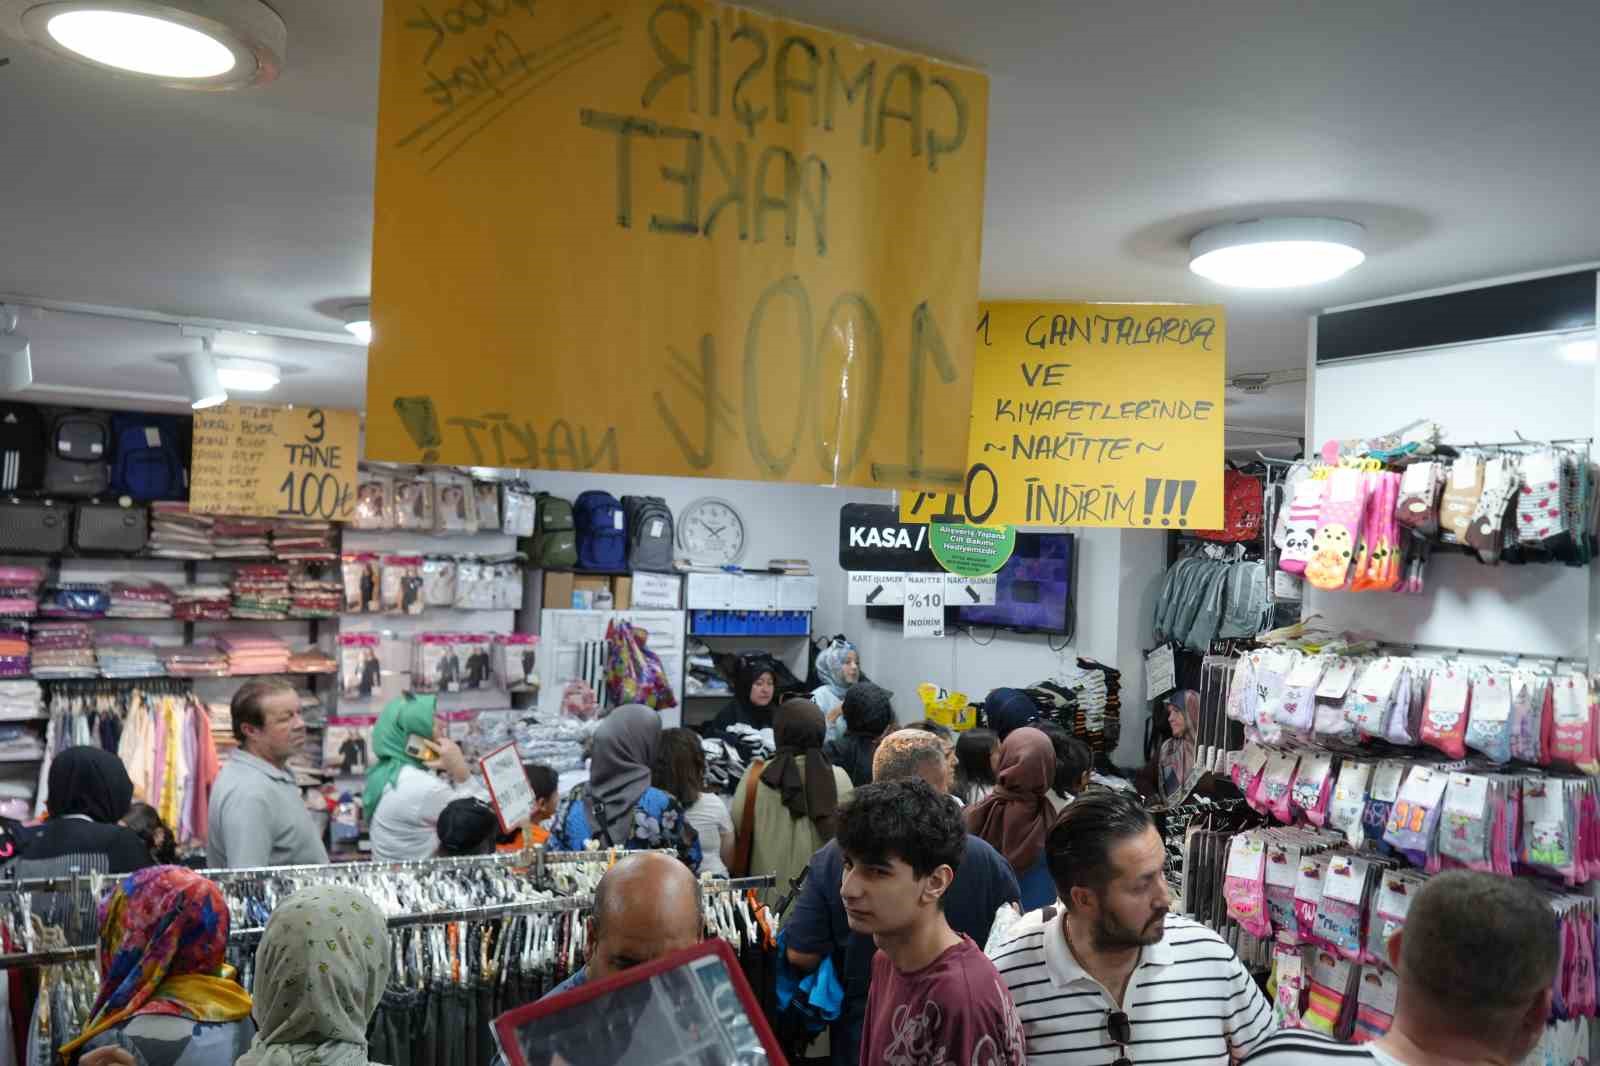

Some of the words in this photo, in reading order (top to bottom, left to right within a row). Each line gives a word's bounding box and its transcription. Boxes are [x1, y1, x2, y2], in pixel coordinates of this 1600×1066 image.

[1021, 363, 1071, 387] VE
[995, 398, 1214, 426] KIYAFETLERİNDE
[304, 409, 326, 443] 3
[284, 444, 342, 468] TANE
[849, 526, 912, 549] KASA
[908, 593, 942, 609] %10
